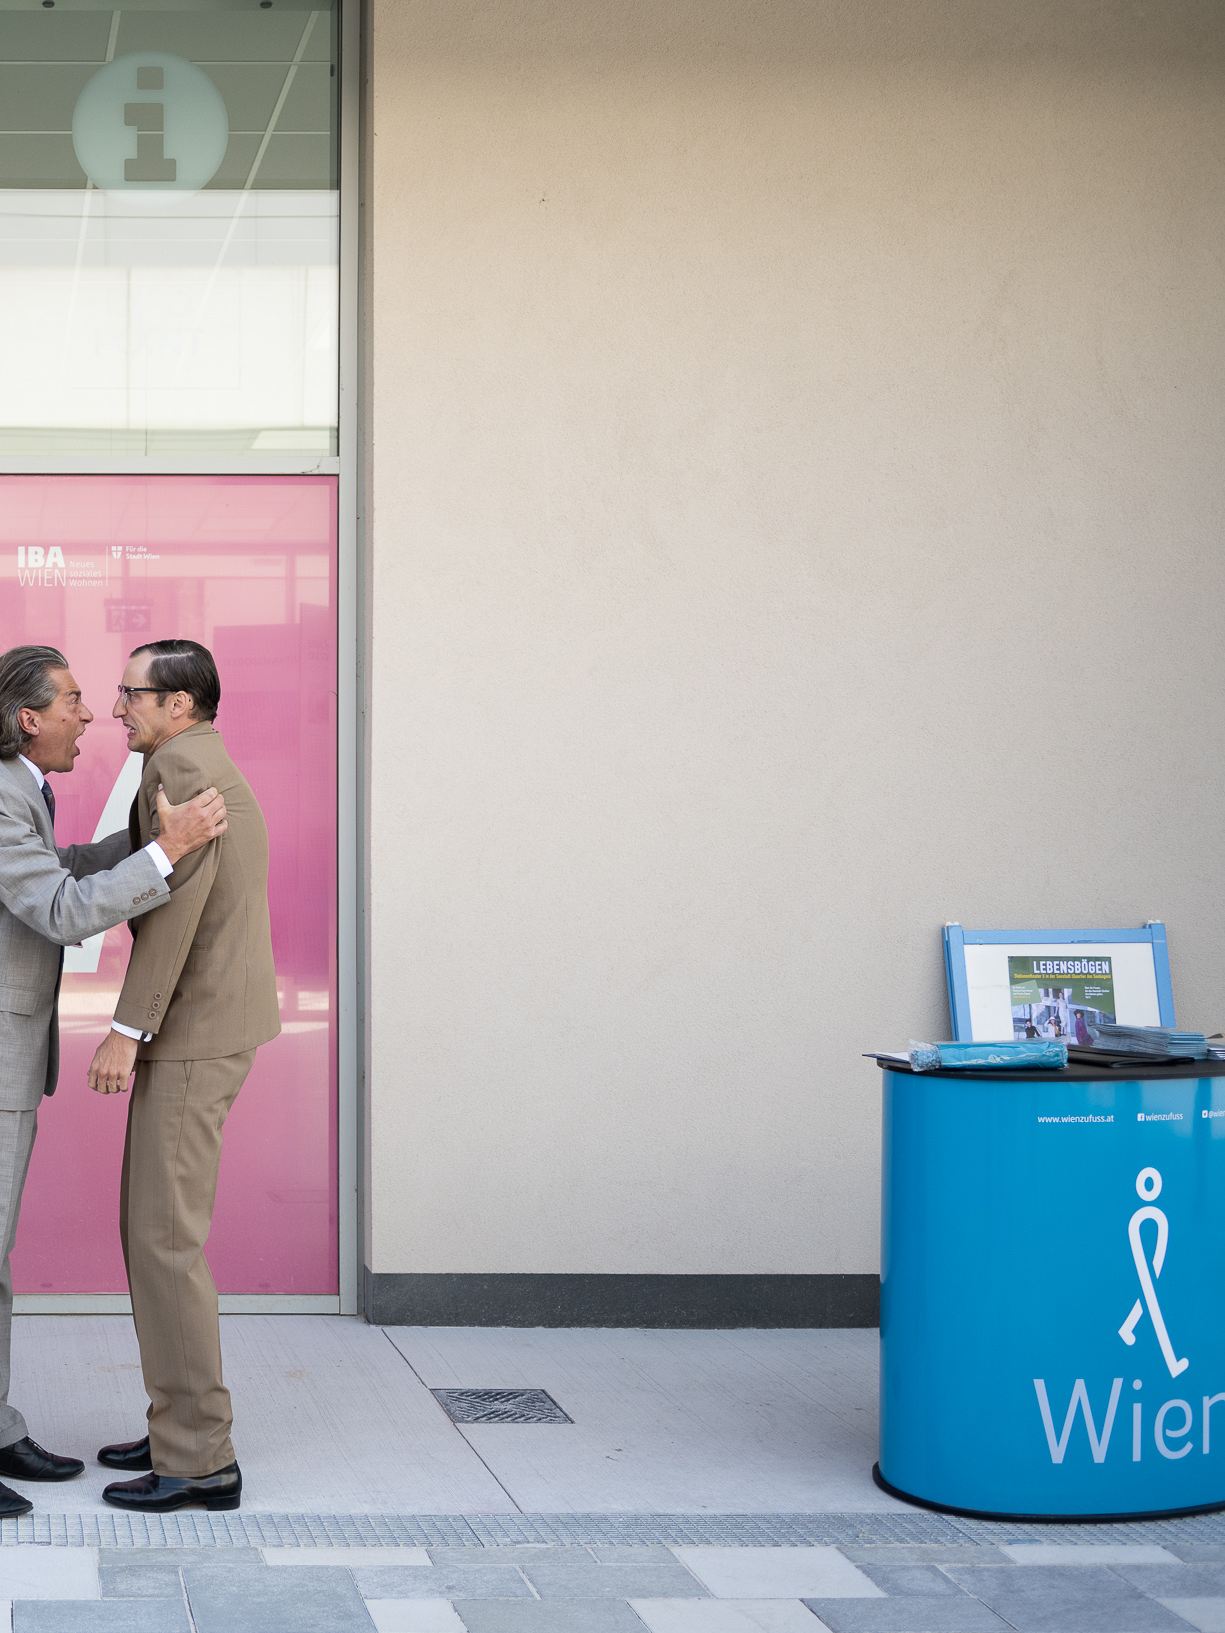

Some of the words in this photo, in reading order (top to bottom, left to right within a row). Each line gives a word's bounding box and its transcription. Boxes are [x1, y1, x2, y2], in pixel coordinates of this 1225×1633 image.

[124, 66, 177, 182] i
[17, 546, 66, 568] IBA
[69, 560, 95, 568] Neues
[17, 569, 66, 587] WIEN
[69, 569, 102, 577] soziales
[69, 578, 103, 587] Wohnen
[1033, 959, 1110, 974] LEBENSBÖGEN
[1037, 1114, 1115, 1123] www.wienzufuss.at
[1145, 1111, 1184, 1121] wienzufuss
[1209, 1109, 1225, 1119] @wie
